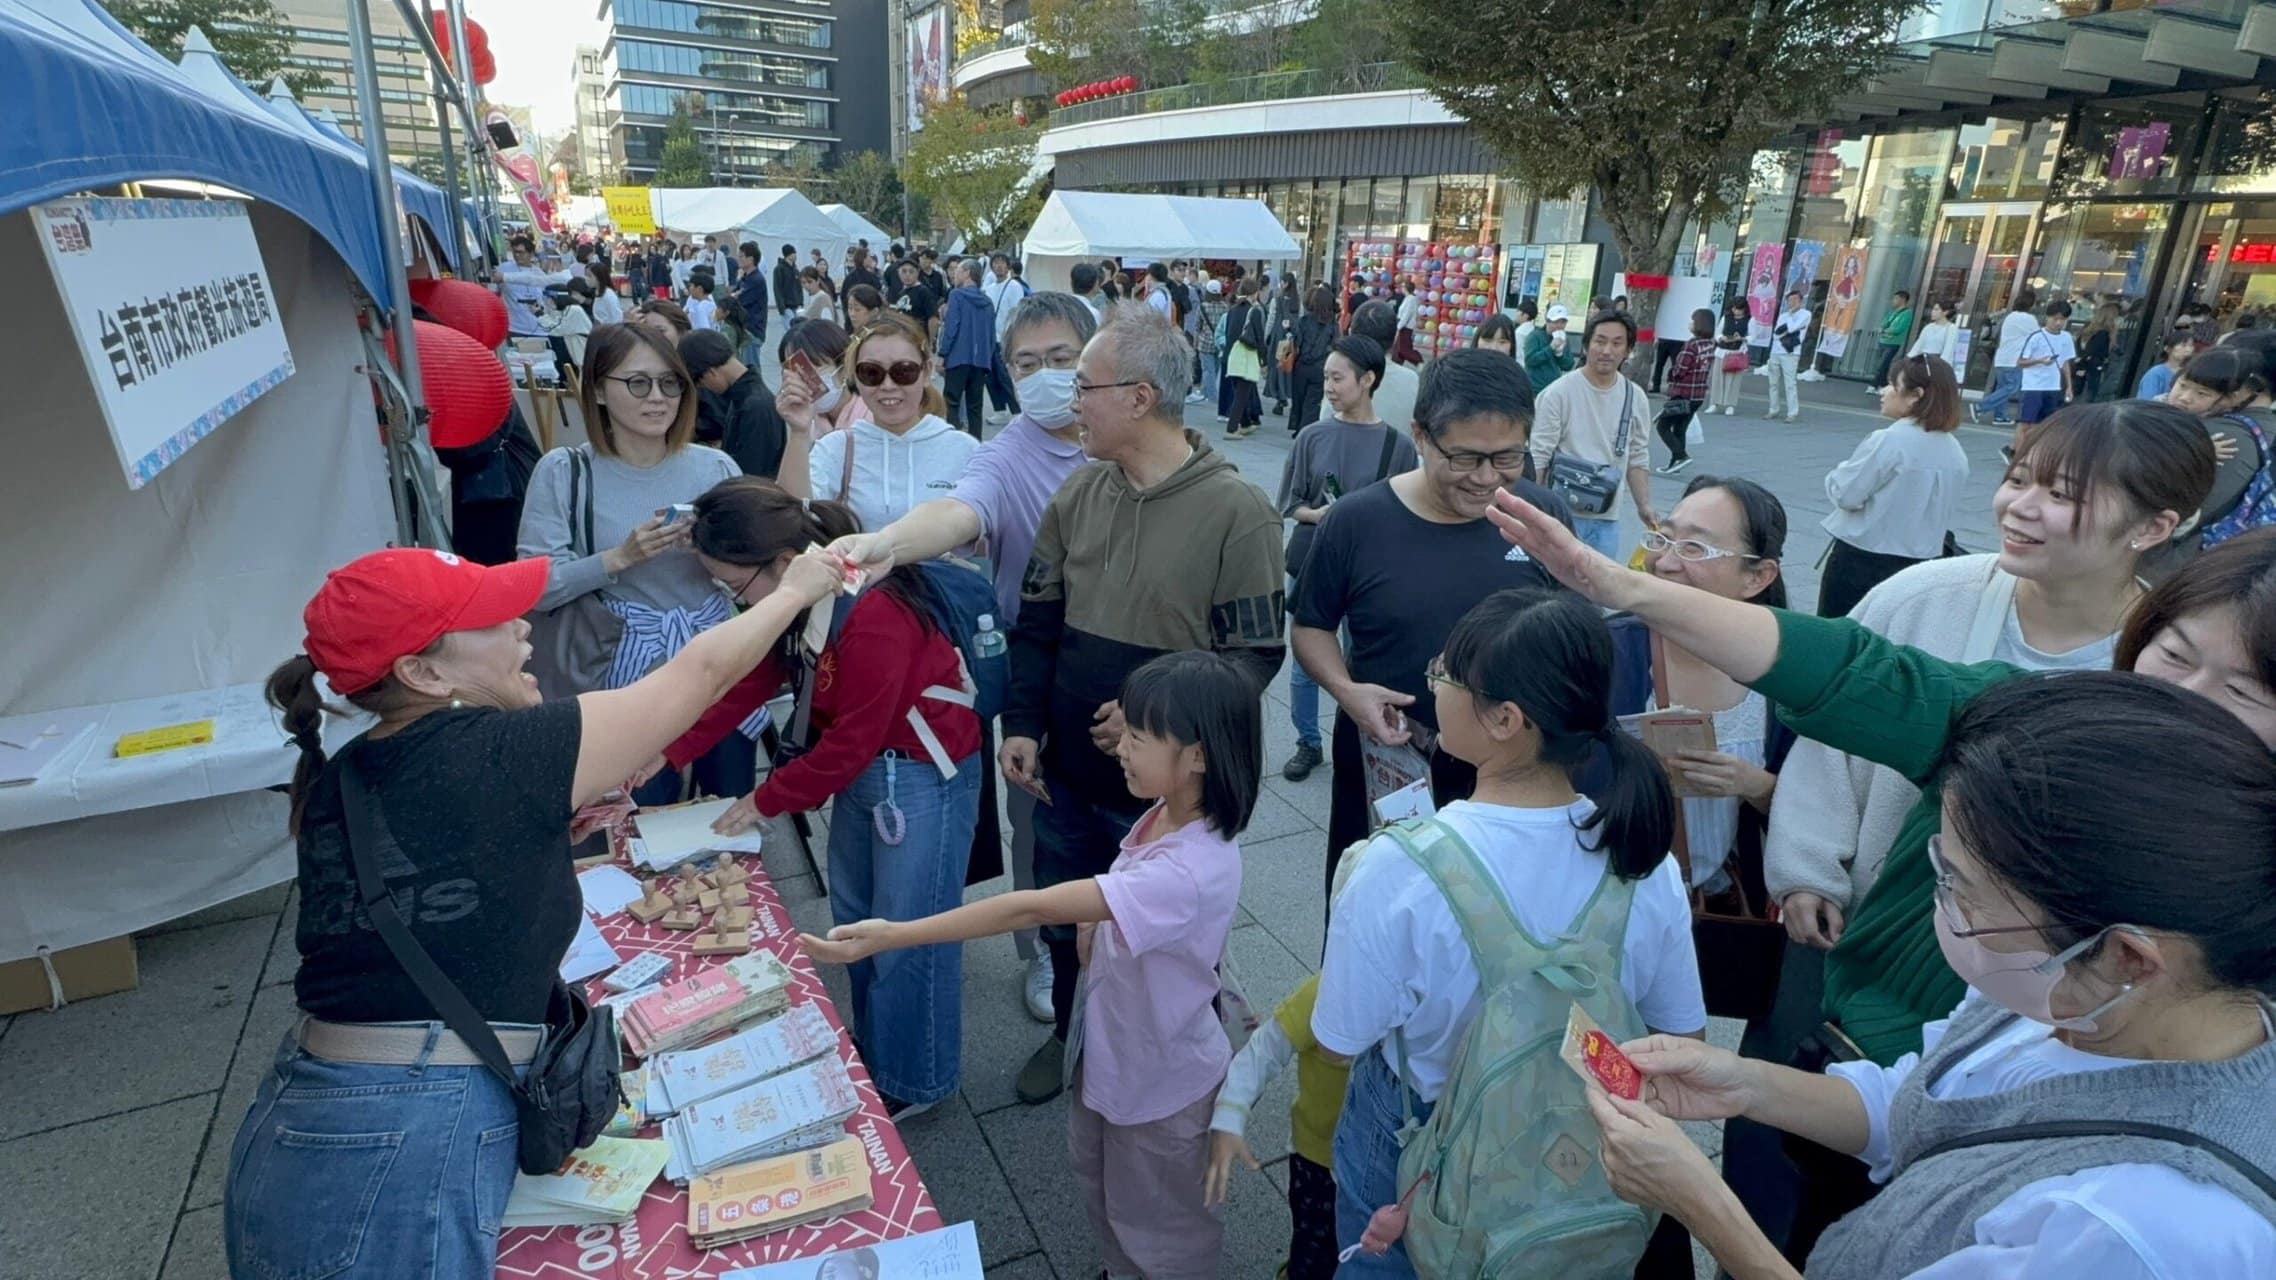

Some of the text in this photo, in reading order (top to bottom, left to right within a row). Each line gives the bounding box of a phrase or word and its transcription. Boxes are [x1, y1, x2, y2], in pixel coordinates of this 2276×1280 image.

[98, 272, 272, 392] 台南市政府觀光旅遊局
[857, 1118, 894, 1176] TAINAN
